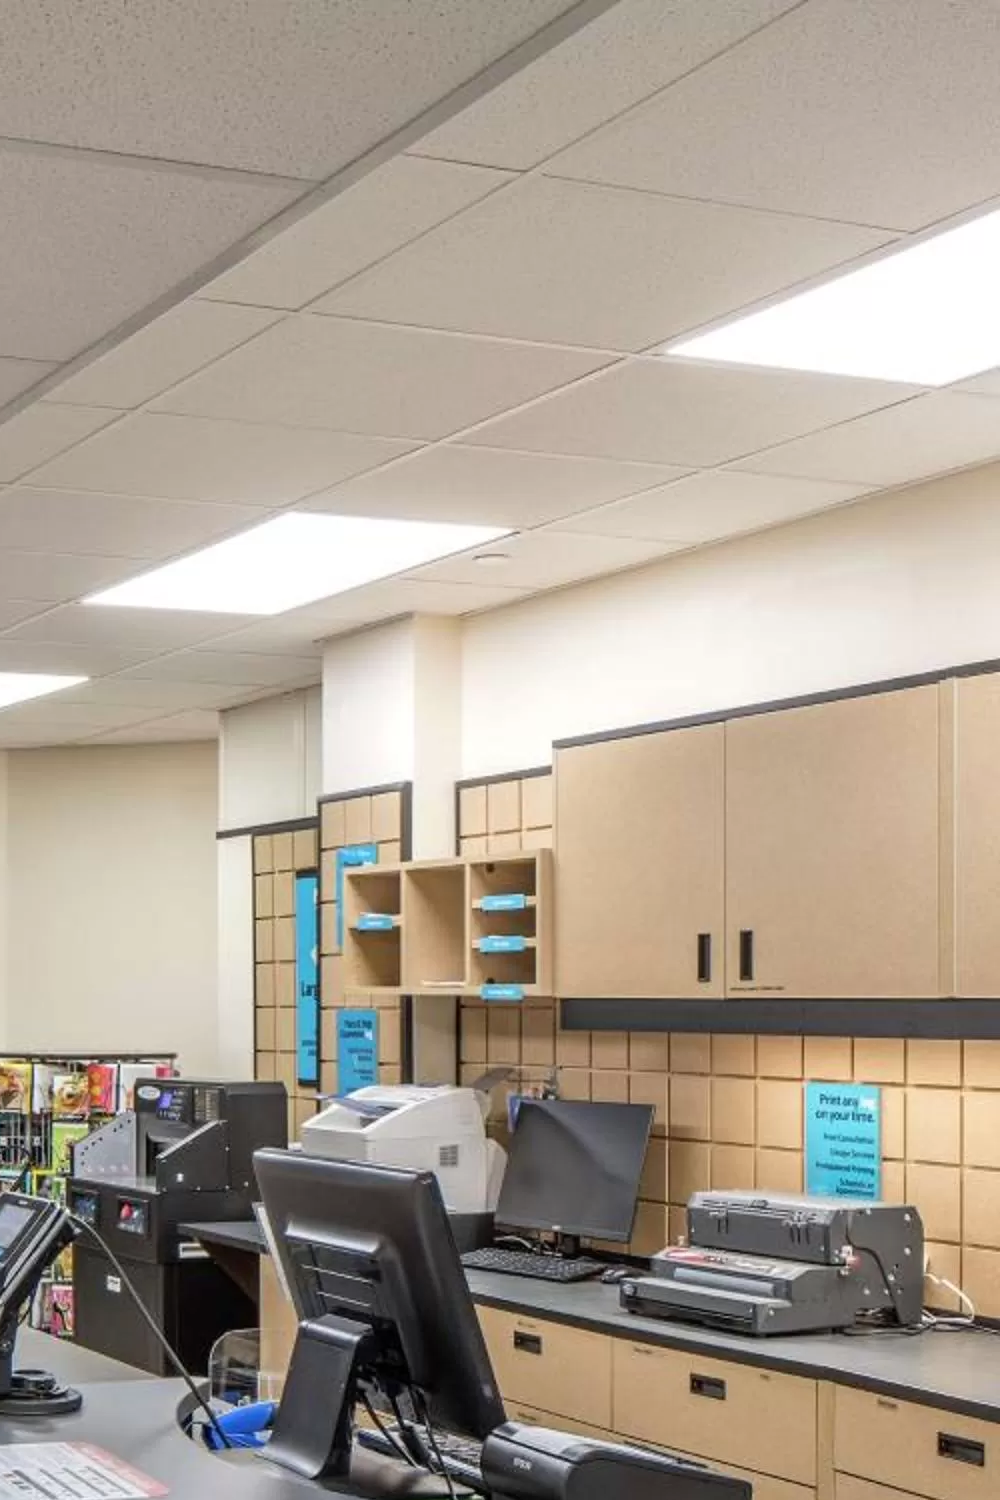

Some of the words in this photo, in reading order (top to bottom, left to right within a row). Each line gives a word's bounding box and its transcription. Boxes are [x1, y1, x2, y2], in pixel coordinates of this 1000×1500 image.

[819, 1094, 841, 1106] Print
[815, 1110, 829, 1120] on
[830, 1111, 850, 1124] your
[851, 1111, 876, 1123] time.
